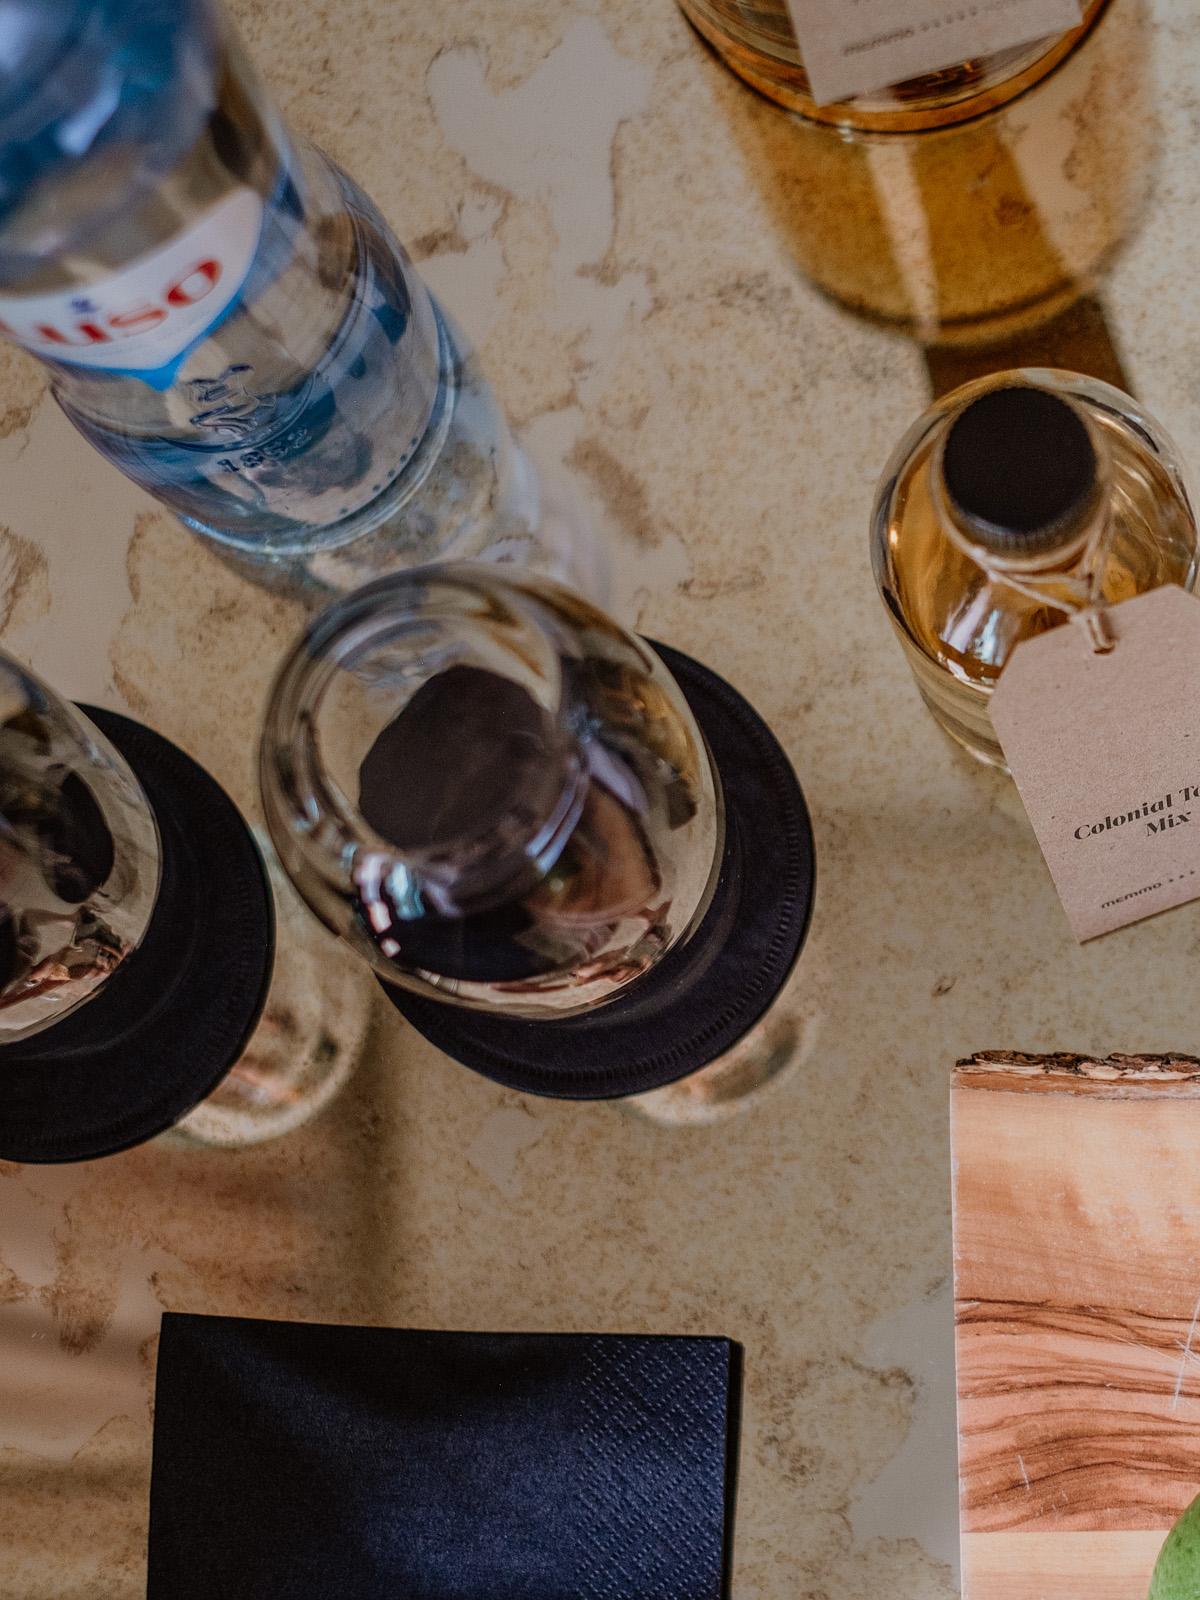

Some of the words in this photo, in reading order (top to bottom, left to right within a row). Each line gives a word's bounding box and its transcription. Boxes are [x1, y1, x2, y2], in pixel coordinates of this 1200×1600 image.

[1073, 793, 1173, 841] Colonial
[1145, 811, 1192, 837] Mix
[1101, 882, 1163, 909] memmo
